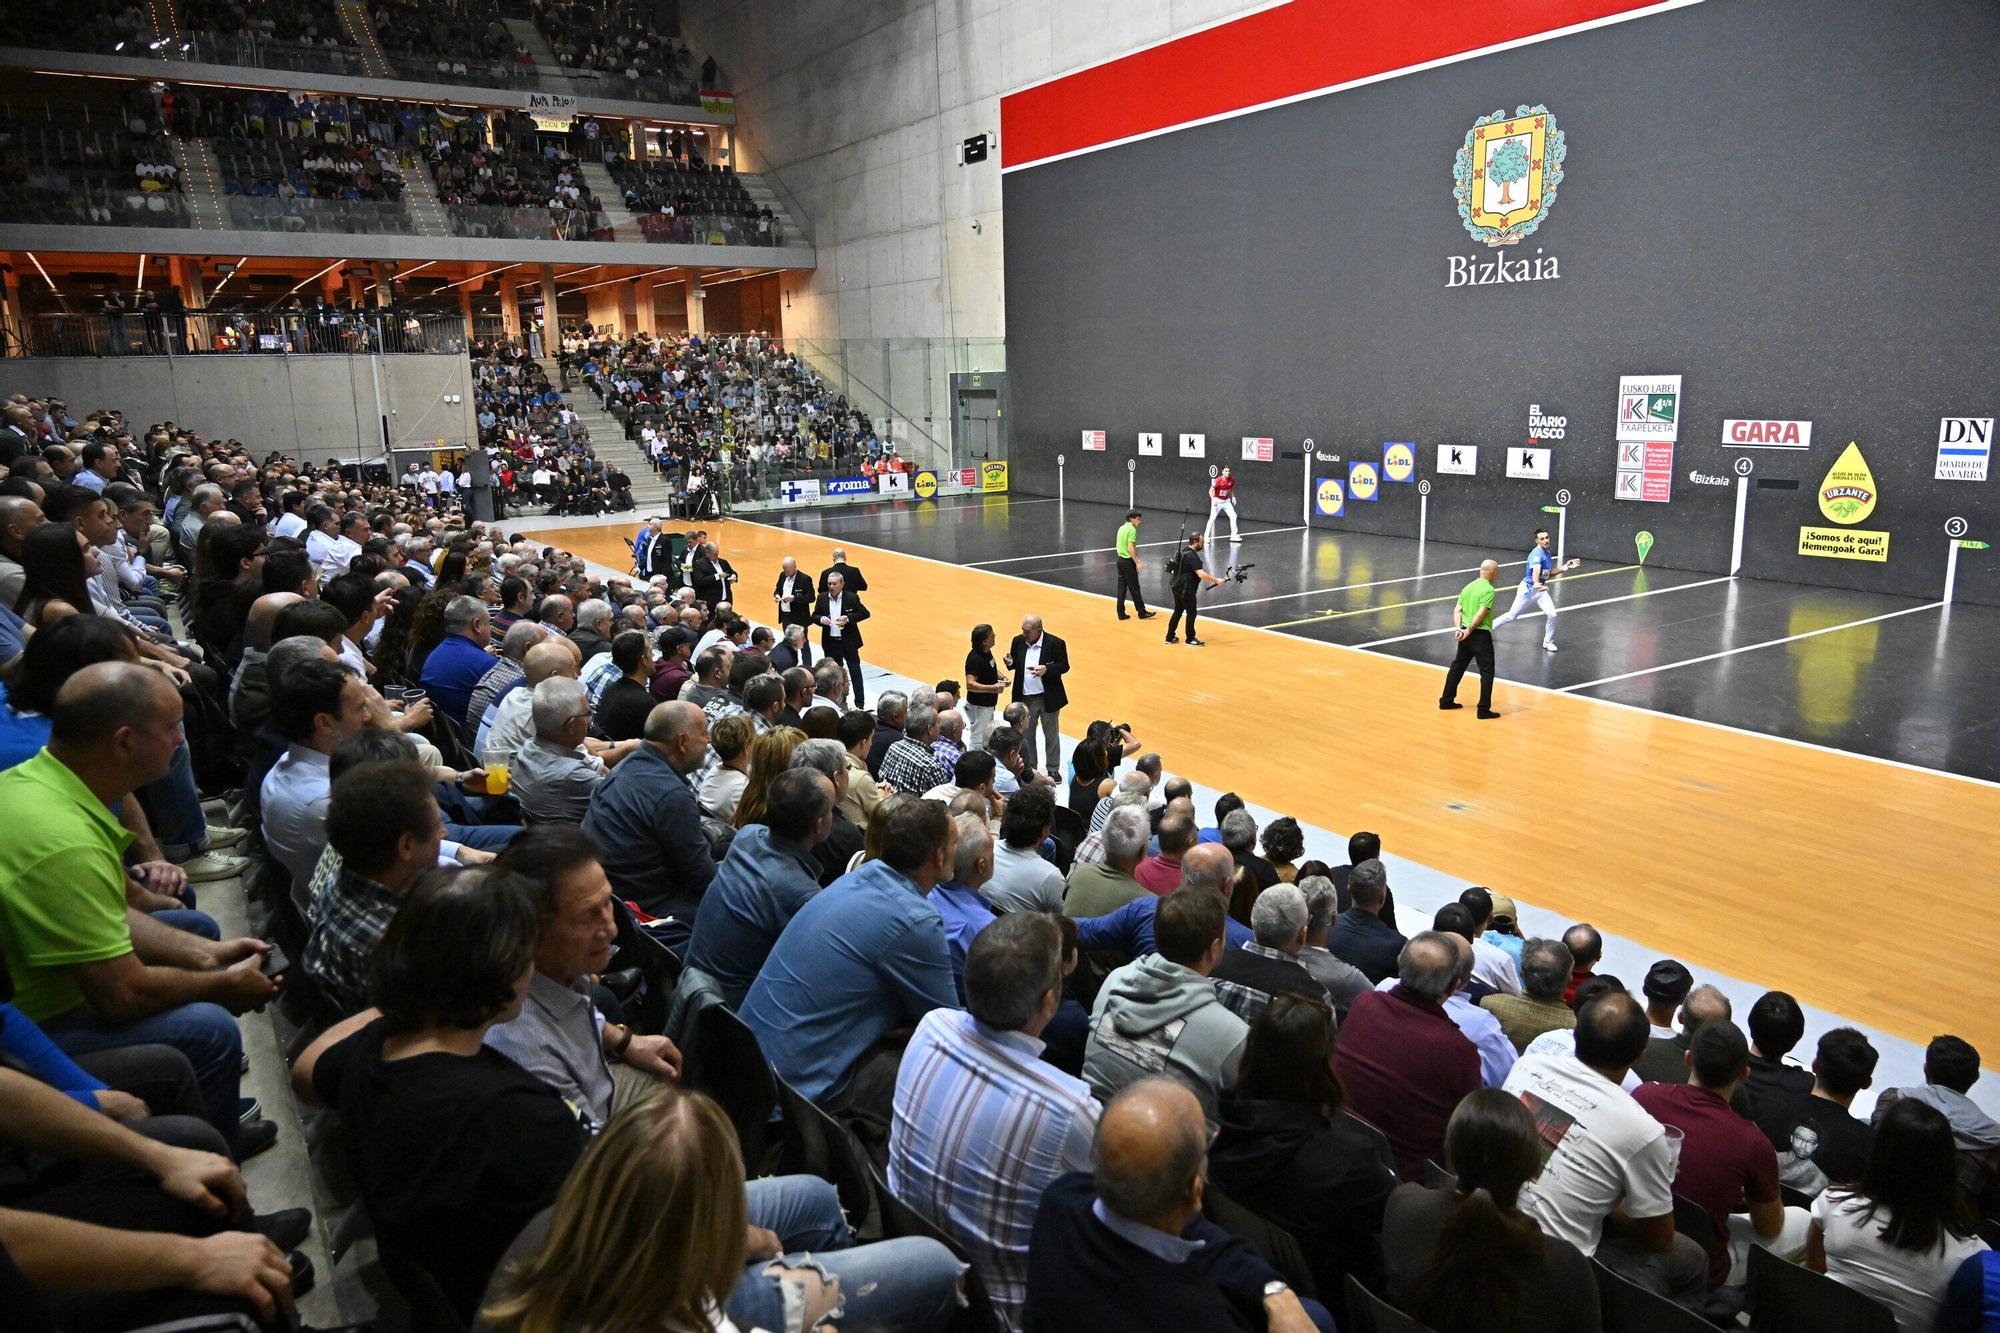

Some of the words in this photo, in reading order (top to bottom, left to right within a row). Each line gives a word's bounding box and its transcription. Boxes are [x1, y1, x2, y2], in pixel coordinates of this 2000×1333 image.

[1444, 247, 1561, 288] Bizkaia
[1622, 384, 1649, 393] EUSKO
[1651, 384, 1676, 393] LABEL
[1529, 404, 1542, 416] EL
[1528, 416, 1567, 428] DIARIO
[1620, 423, 1674, 432] TXAPELKETA
[1528, 428, 1565, 440] VASCO
[1731, 421, 1800, 444] GARA
[1942, 419, 1990, 443] DN
[1739, 460, 1748, 472] 4
[1939, 460, 1970, 469] DIARIO
[1972, 461, 1985, 469] DE
[1695, 474, 1730, 486] Bizkaia
[1939, 469, 1984, 479] NAVARRA
[1421, 482, 1427, 492] 6
[1560, 491, 1567, 502] 5
[1826, 488, 1869, 501] URZANTE
[1950, 520, 1961, 534] 3
[1806, 531, 1840, 542] ¡Somos
[1843, 534, 1855, 543] de
[1857, 537, 1882, 547] aquí!
[1957, 540, 1983, 550] FALTA
[1802, 541, 1855, 554] Hemengoak
[1858, 546, 1885, 556] Gara!
